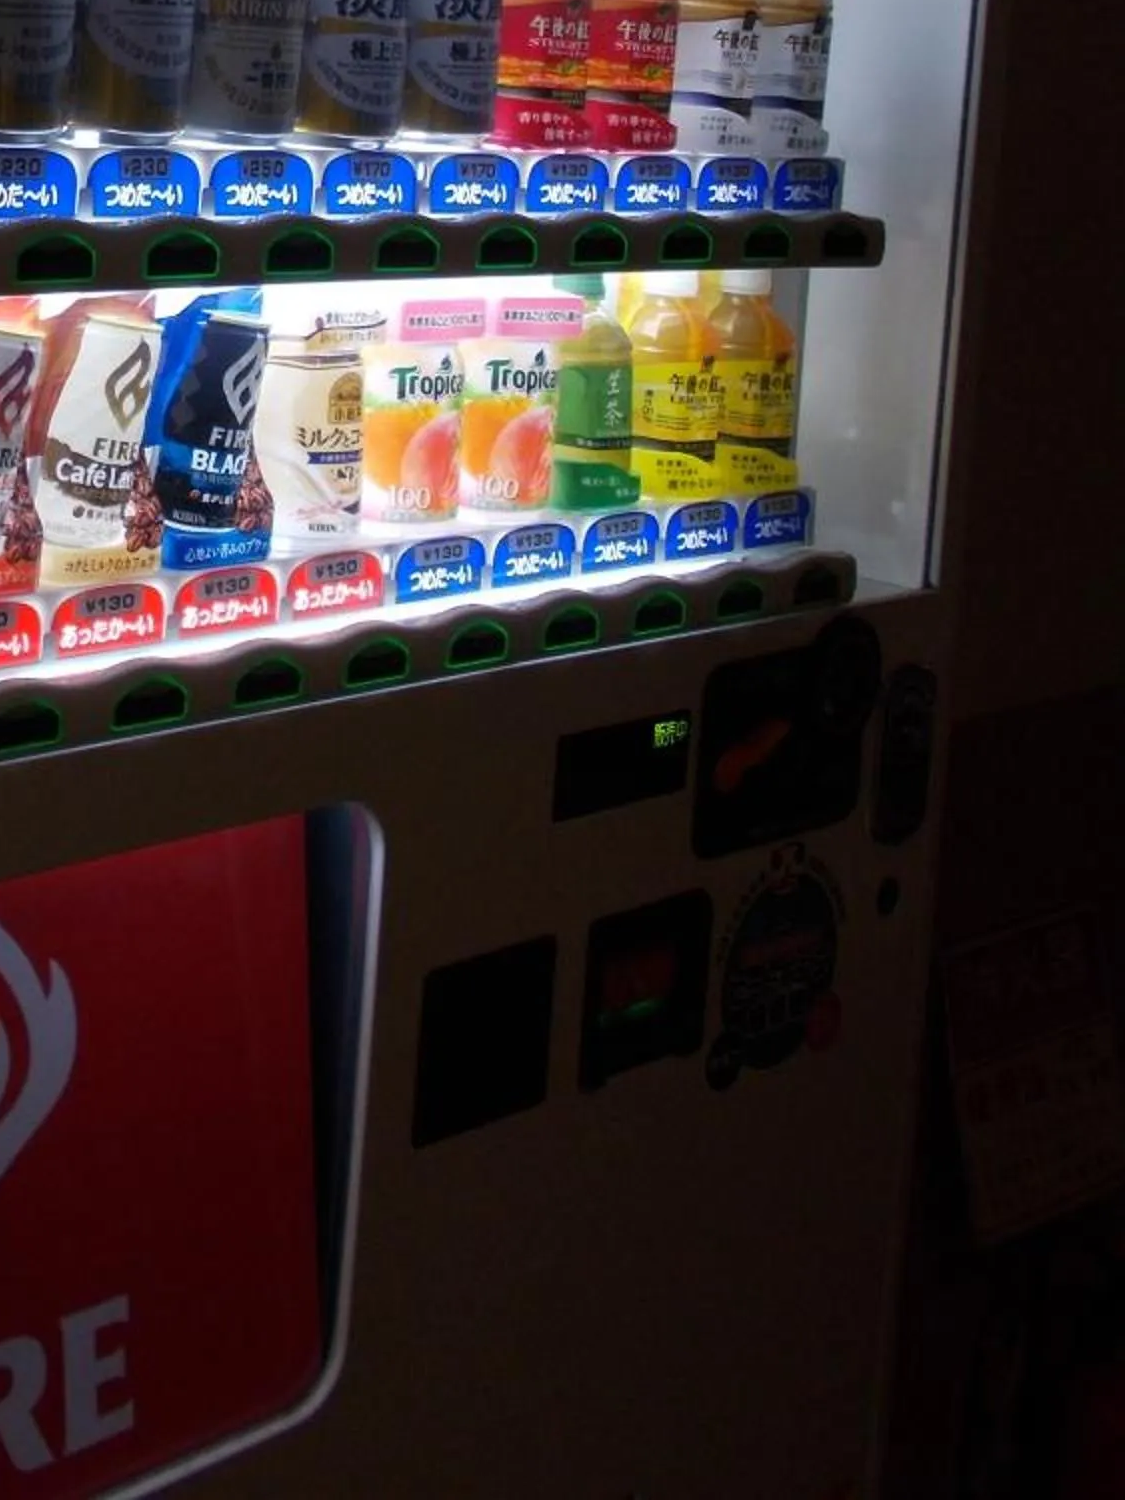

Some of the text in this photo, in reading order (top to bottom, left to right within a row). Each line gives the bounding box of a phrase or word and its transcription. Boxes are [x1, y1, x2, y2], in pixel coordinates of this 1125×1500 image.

[104, 184, 183, 208] つめた～い
[225, 184, 299, 207] つめた～い
[336, 184, 403, 206] つめた～い
[444, 184, 507, 205] つめた～い
[539, 184, 597, 204] つめた～い
[604, 367, 624, 429] 生茶
[55, 458, 106, 486] Café
[191, 449, 250, 475] BLAC
[515, 530, 554, 549] ¥130
[315, 558, 359, 581] ¥130
[505, 550, 564, 577] つめた～い
[203, 575, 251, 598] ¥130
[409, 563, 473, 592] つめた～い
[85, 592, 136, 614] ¥130
[292, 580, 375, 612] あったか～い
[181, 598, 269, 630] あったか～い
[58, 613, 155, 650] あったか～い
